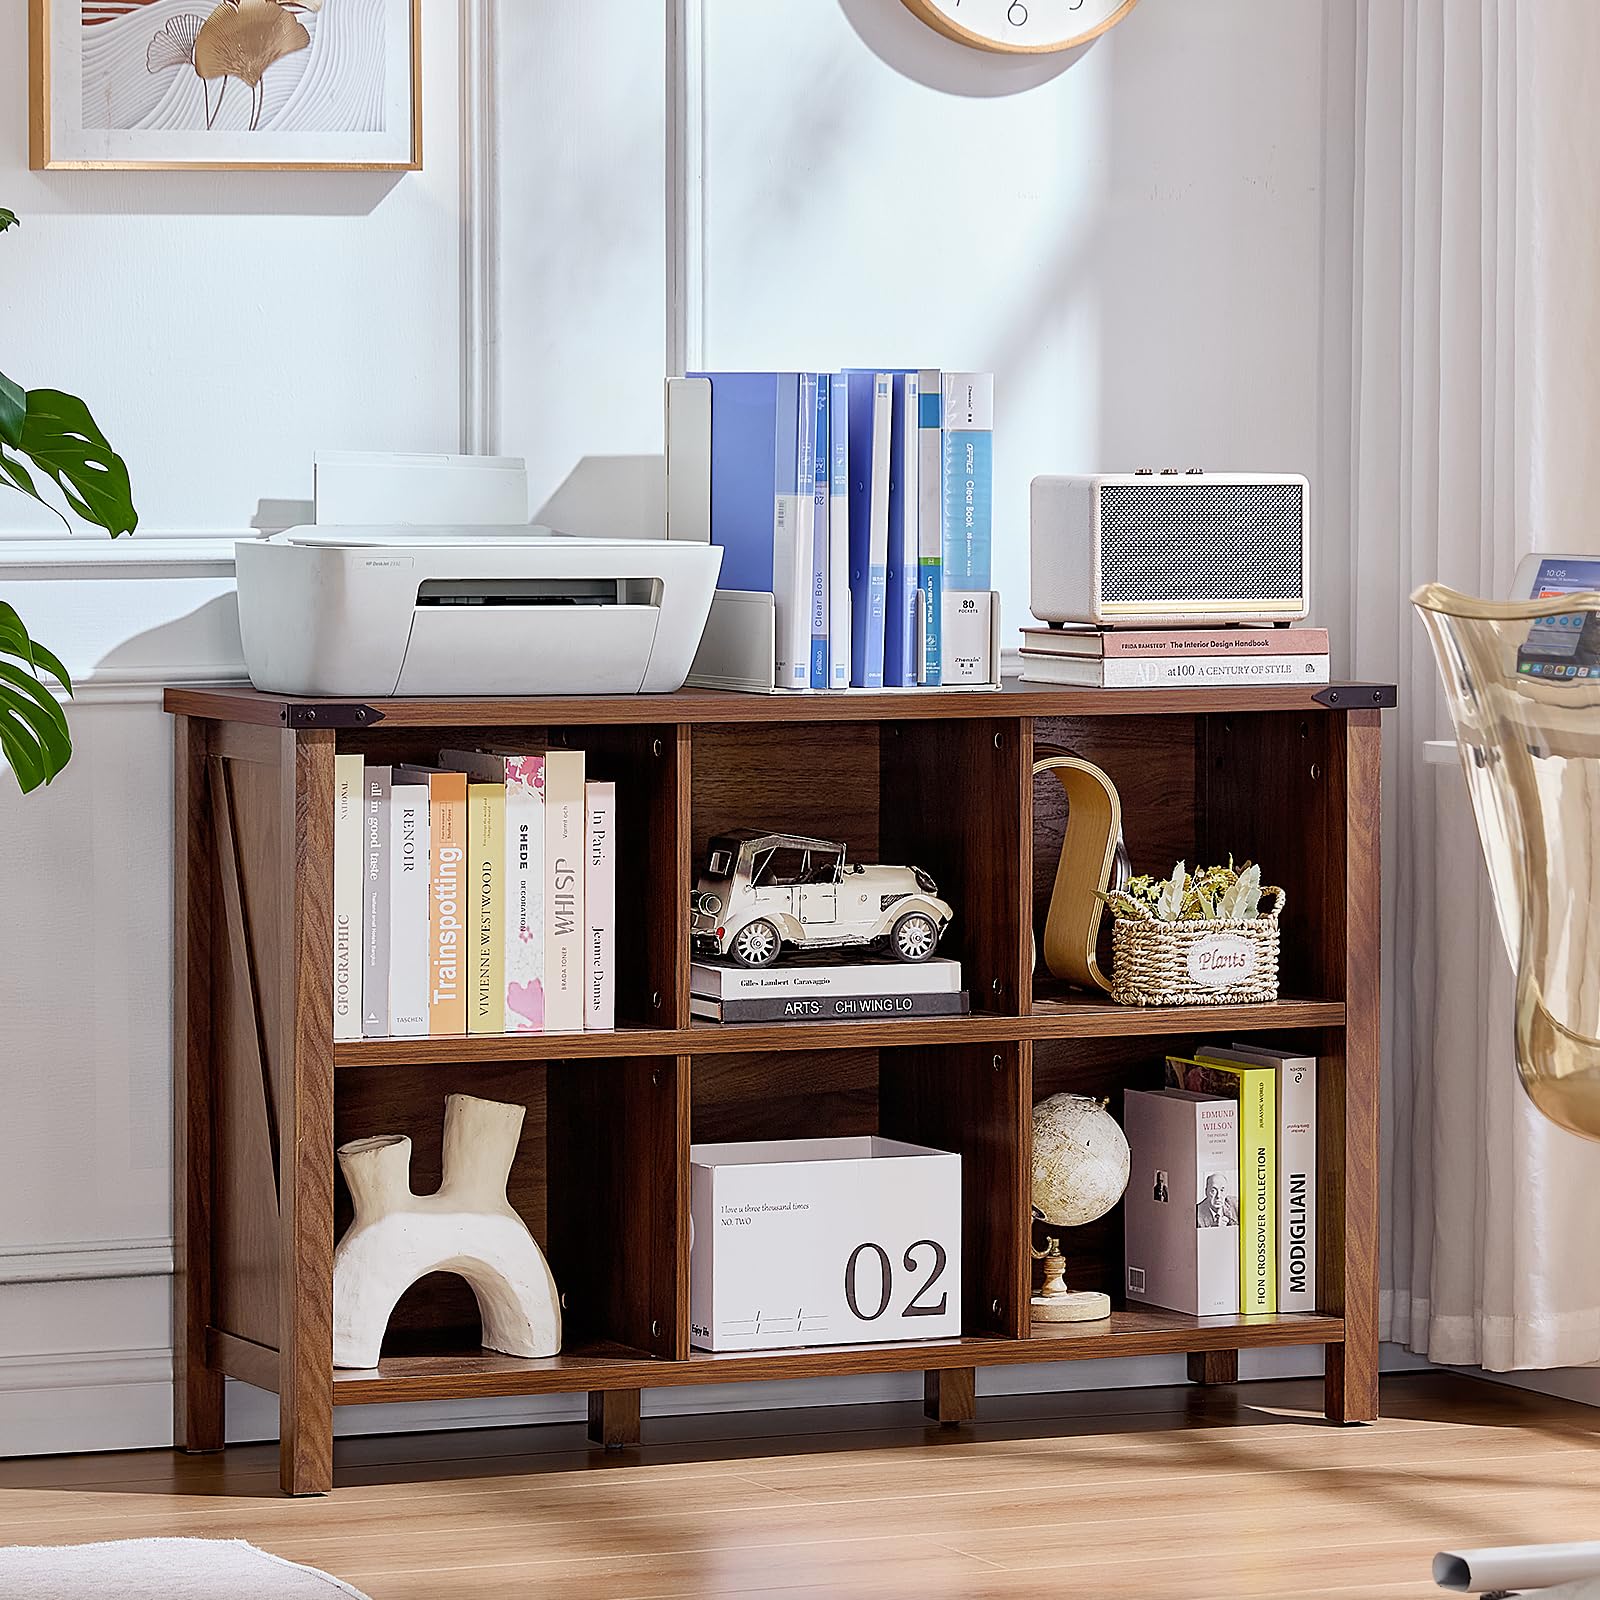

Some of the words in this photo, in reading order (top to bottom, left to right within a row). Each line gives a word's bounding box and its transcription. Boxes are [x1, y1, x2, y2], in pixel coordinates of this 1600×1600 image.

[1007, 0, 1028, 26] 6
[966, 480, 974, 505] Clear
[966, 506, 974, 528] Book
[815, 571, 823, 597] Book
[815, 600, 823, 627] Clear
[962, 600, 975, 609] 80
[1170, 641, 1183, 649] The
[1210, 640, 1233, 649] Design
[1234, 639, 1270, 647] Handbook
[1206, 666, 1250, 675] CENTURY
[1251, 665, 1264, 674] OF
[1265, 664, 1292, 674] STYLE
[340, 780, 349, 820] NATIONAL
[371, 782, 382, 796] all
[370, 801, 382, 813] in
[593, 810, 606, 824] In
[367, 817, 382, 848] good
[403, 809, 415, 872] RENOIR
[519, 824, 529, 870] SHEDE
[592, 830, 606, 866] Paris
[369, 853, 380, 881] taste
[481, 861, 492, 946] WESTWOOD
[554, 858, 576, 936] WHISP
[433, 847, 463, 1005] Trainspotting
[592, 926, 604, 967] Jeanne
[1198, 948, 1246, 971] Plants
[479, 948, 490, 1016] VIVIENNE
[593, 971, 604, 1011] Damas
[740, 979, 759, 987] Gilles
[760, 978, 789, 986] Lambert
[793, 977, 830, 986] Caravaggio
[835, 1000, 856, 1014] CHI
[859, 999, 893, 1013] WING
[895, 998, 913, 1011] LO
[1201, 1110, 1234, 1119] EDMUND
[1203, 1121, 1233, 1131] WILSON
[1257, 1147, 1266, 1211] COLLECTION
[725, 1205, 737, 1213] love
[744, 1204, 760, 1212] three
[762, 1202, 791, 1212] thousand
[793, 1202, 809, 1210] times
[721, 1218, 734, 1226] NO.
[735, 1217, 752, 1225] TWO
[1289, 1173, 1306, 1293] MODIGLIANI
[1257, 1215, 1266, 1276] CROSSOVER
[844, 1239, 948, 1321] 02
[1257, 1279, 1266, 1304] FION
[691, 1323, 703, 1337] Enjoy
[702, 1325, 710, 1338] life
